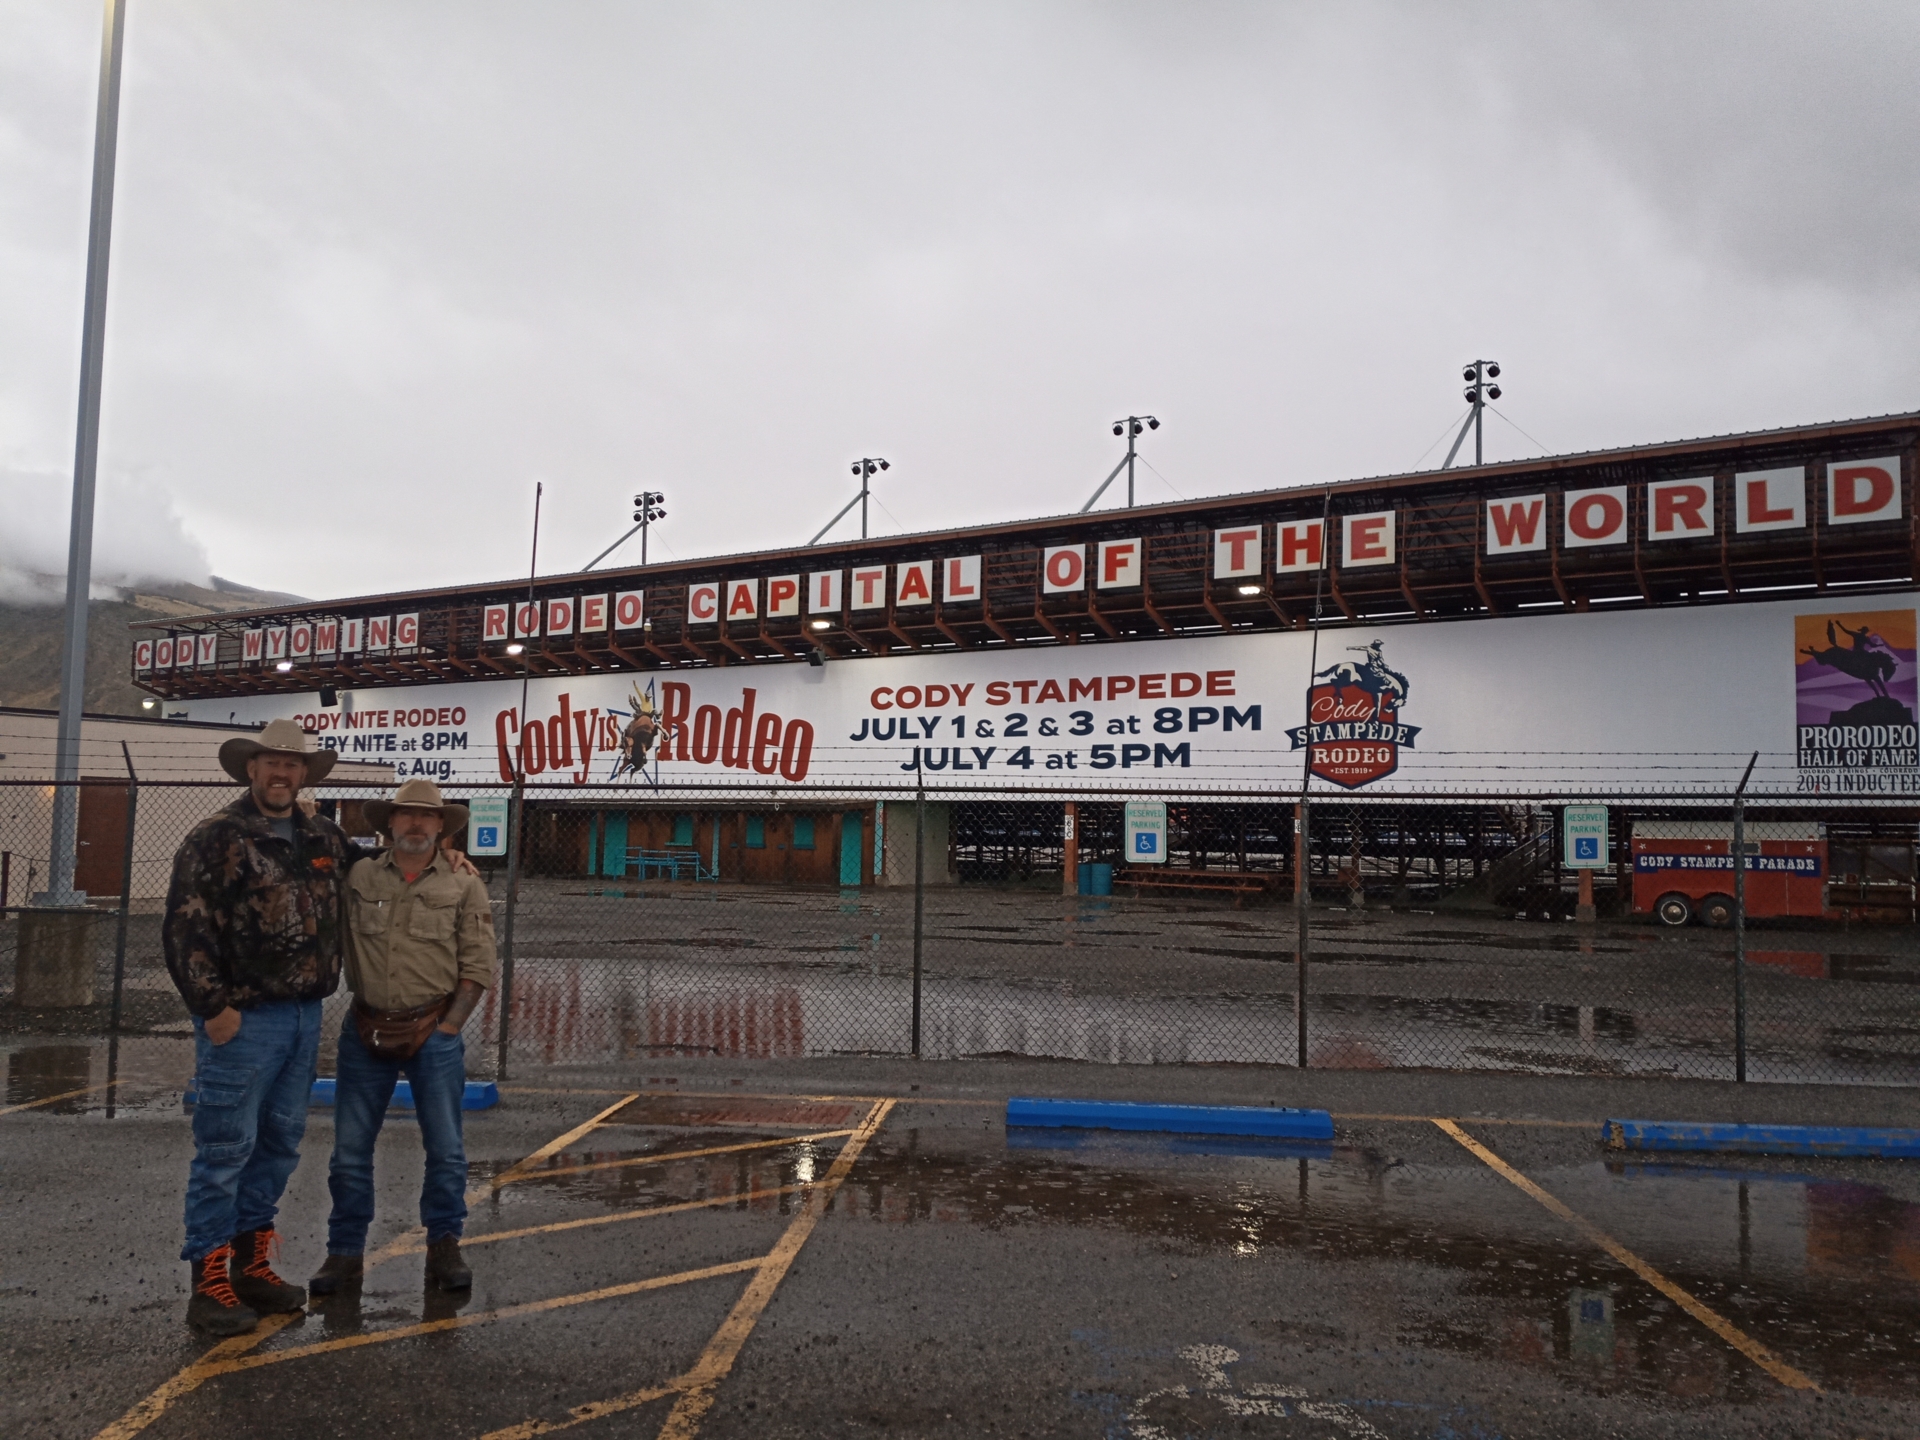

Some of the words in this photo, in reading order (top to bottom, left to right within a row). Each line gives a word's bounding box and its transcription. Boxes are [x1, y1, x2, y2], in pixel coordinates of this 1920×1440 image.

[137, 637, 216, 667] CODY
[245, 617, 417, 657] WYOMING
[486, 594, 642, 636] RODEO
[690, 559, 975, 619] CAPITAL
[1046, 544, 1135, 588] OF
[1220, 516, 1387, 571] THE
[1488, 466, 1895, 547] WORLD
[870, 683, 976, 710] CODY
[985, 670, 1236, 706] STAMPEDE
[345, 710, 389, 729] NITE
[393, 706, 467, 728] RODEO
[1310, 696, 1377, 725] Cody
[496, 693, 600, 785] Cody
[598, 715, 618, 752] IS
[657, 681, 815, 782] Rodeo
[849, 715, 943, 741] JULY
[951, 715, 966, 738] 1
[974, 719, 995, 738] &
[1004, 713, 1029, 737] 2
[1038, 717, 1060, 737] &
[1068, 710, 1095, 736] 3
[1106, 715, 1141, 734] at
[1153, 704, 1262, 734] 8PM
[317, 735, 350, 753] ERY
[353, 733, 398, 753] NITE
[401, 737, 417, 751] at
[421, 732, 468, 751] 8PM
[1296, 723, 1409, 746] STAMPEDE
[1800, 725, 1917, 749] PRORODEO
[900, 746, 997, 772] JULY
[1006, 746, 1035, 769] 4
[1045, 751, 1078, 769] at
[1089, 742, 1191, 769] 5PM
[1313, 747, 1391, 764] RODEO
[1800, 749, 1844, 767] HALL
[1846, 749, 1868, 766] OF
[1871, 749, 1918, 766] FAME
[397, 761, 408, 776] &
[411, 758, 457, 781] Aug.
[1797, 774, 1831, 792] 2019
[1129, 809, 1163, 817] RESERVED
[1568, 813, 1605, 821] RESERVED
[1131, 821, 1161, 829] PARKING
[1570, 825, 1603, 833] PARKING
[1640, 856, 1674, 867] CODY
[1681, 857, 1753, 868] STAMPEE
[1759, 858, 1815, 870] PARADE
